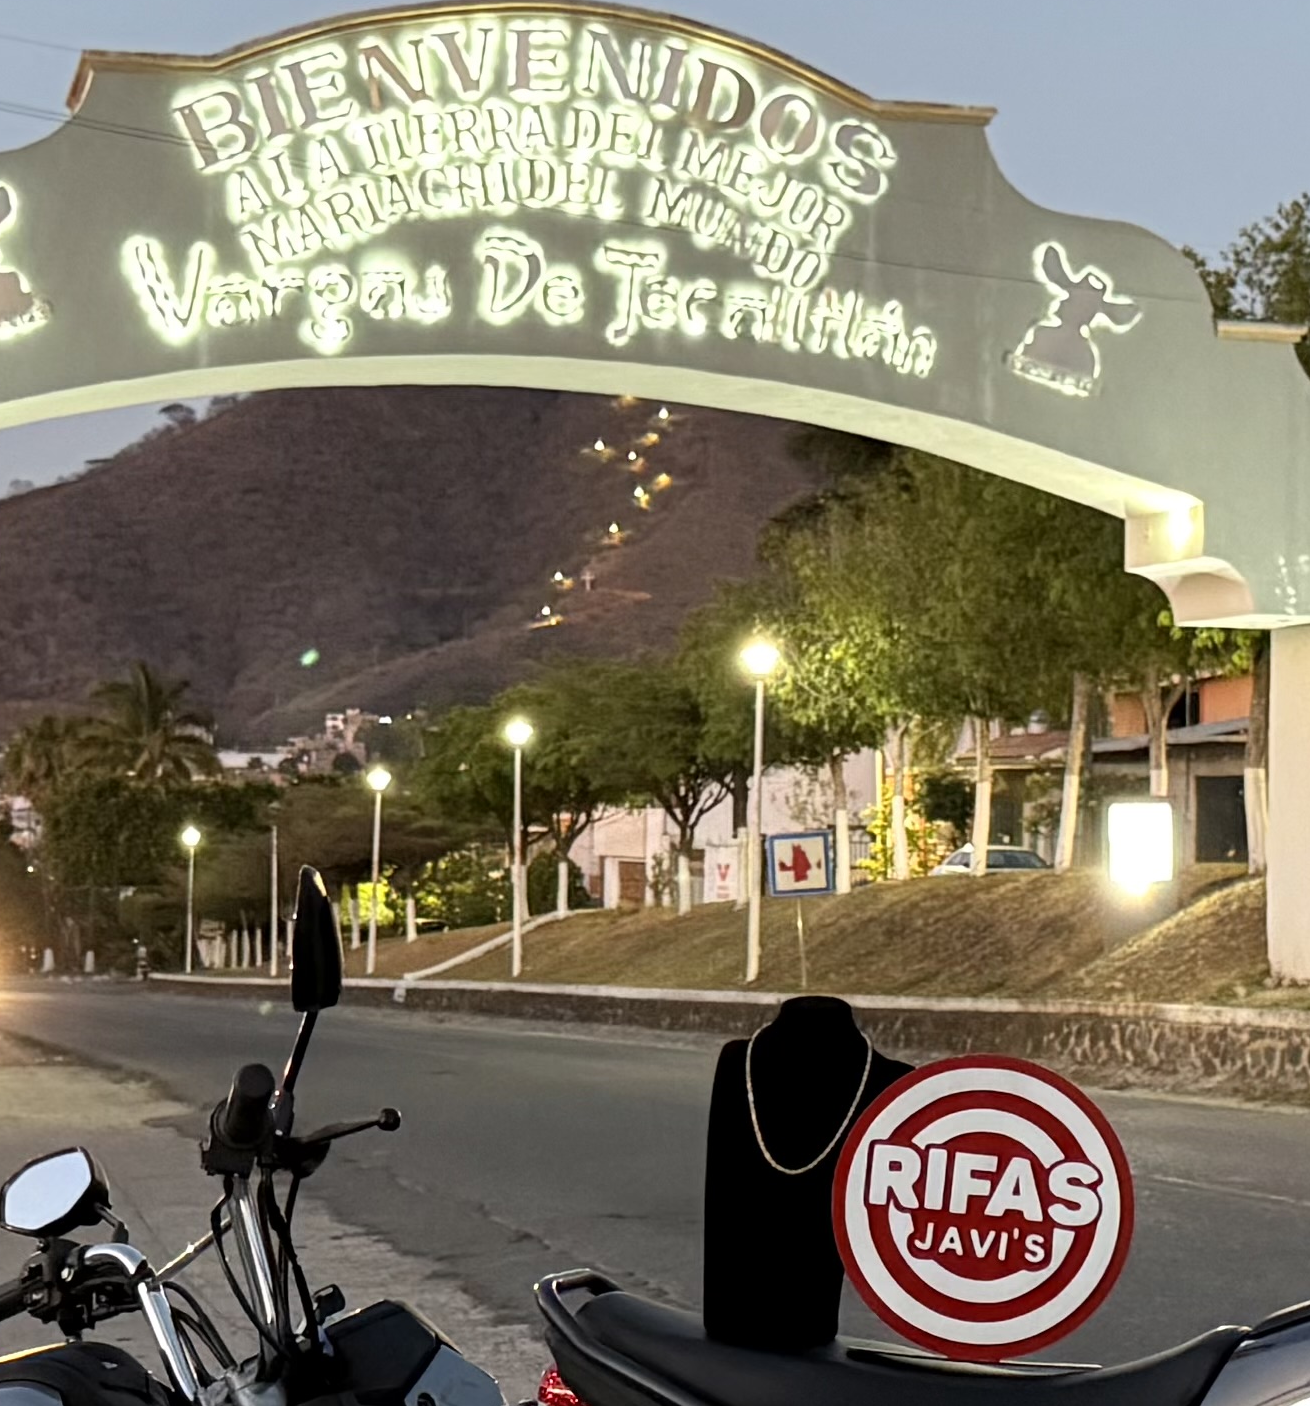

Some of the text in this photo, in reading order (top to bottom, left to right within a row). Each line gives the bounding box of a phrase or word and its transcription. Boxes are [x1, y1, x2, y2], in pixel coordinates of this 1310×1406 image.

[171, 25, 897, 197] BIENVENIDOS
[236, 168, 271, 215] A
[679, 130, 847, 251] MEJOR
[241, 160, 517, 268] MARIACHI
[481, 233, 581, 317] De
[868, 1143, 1101, 1227] RIFAS
[913, 1221, 1045, 1263] JAVI'S
